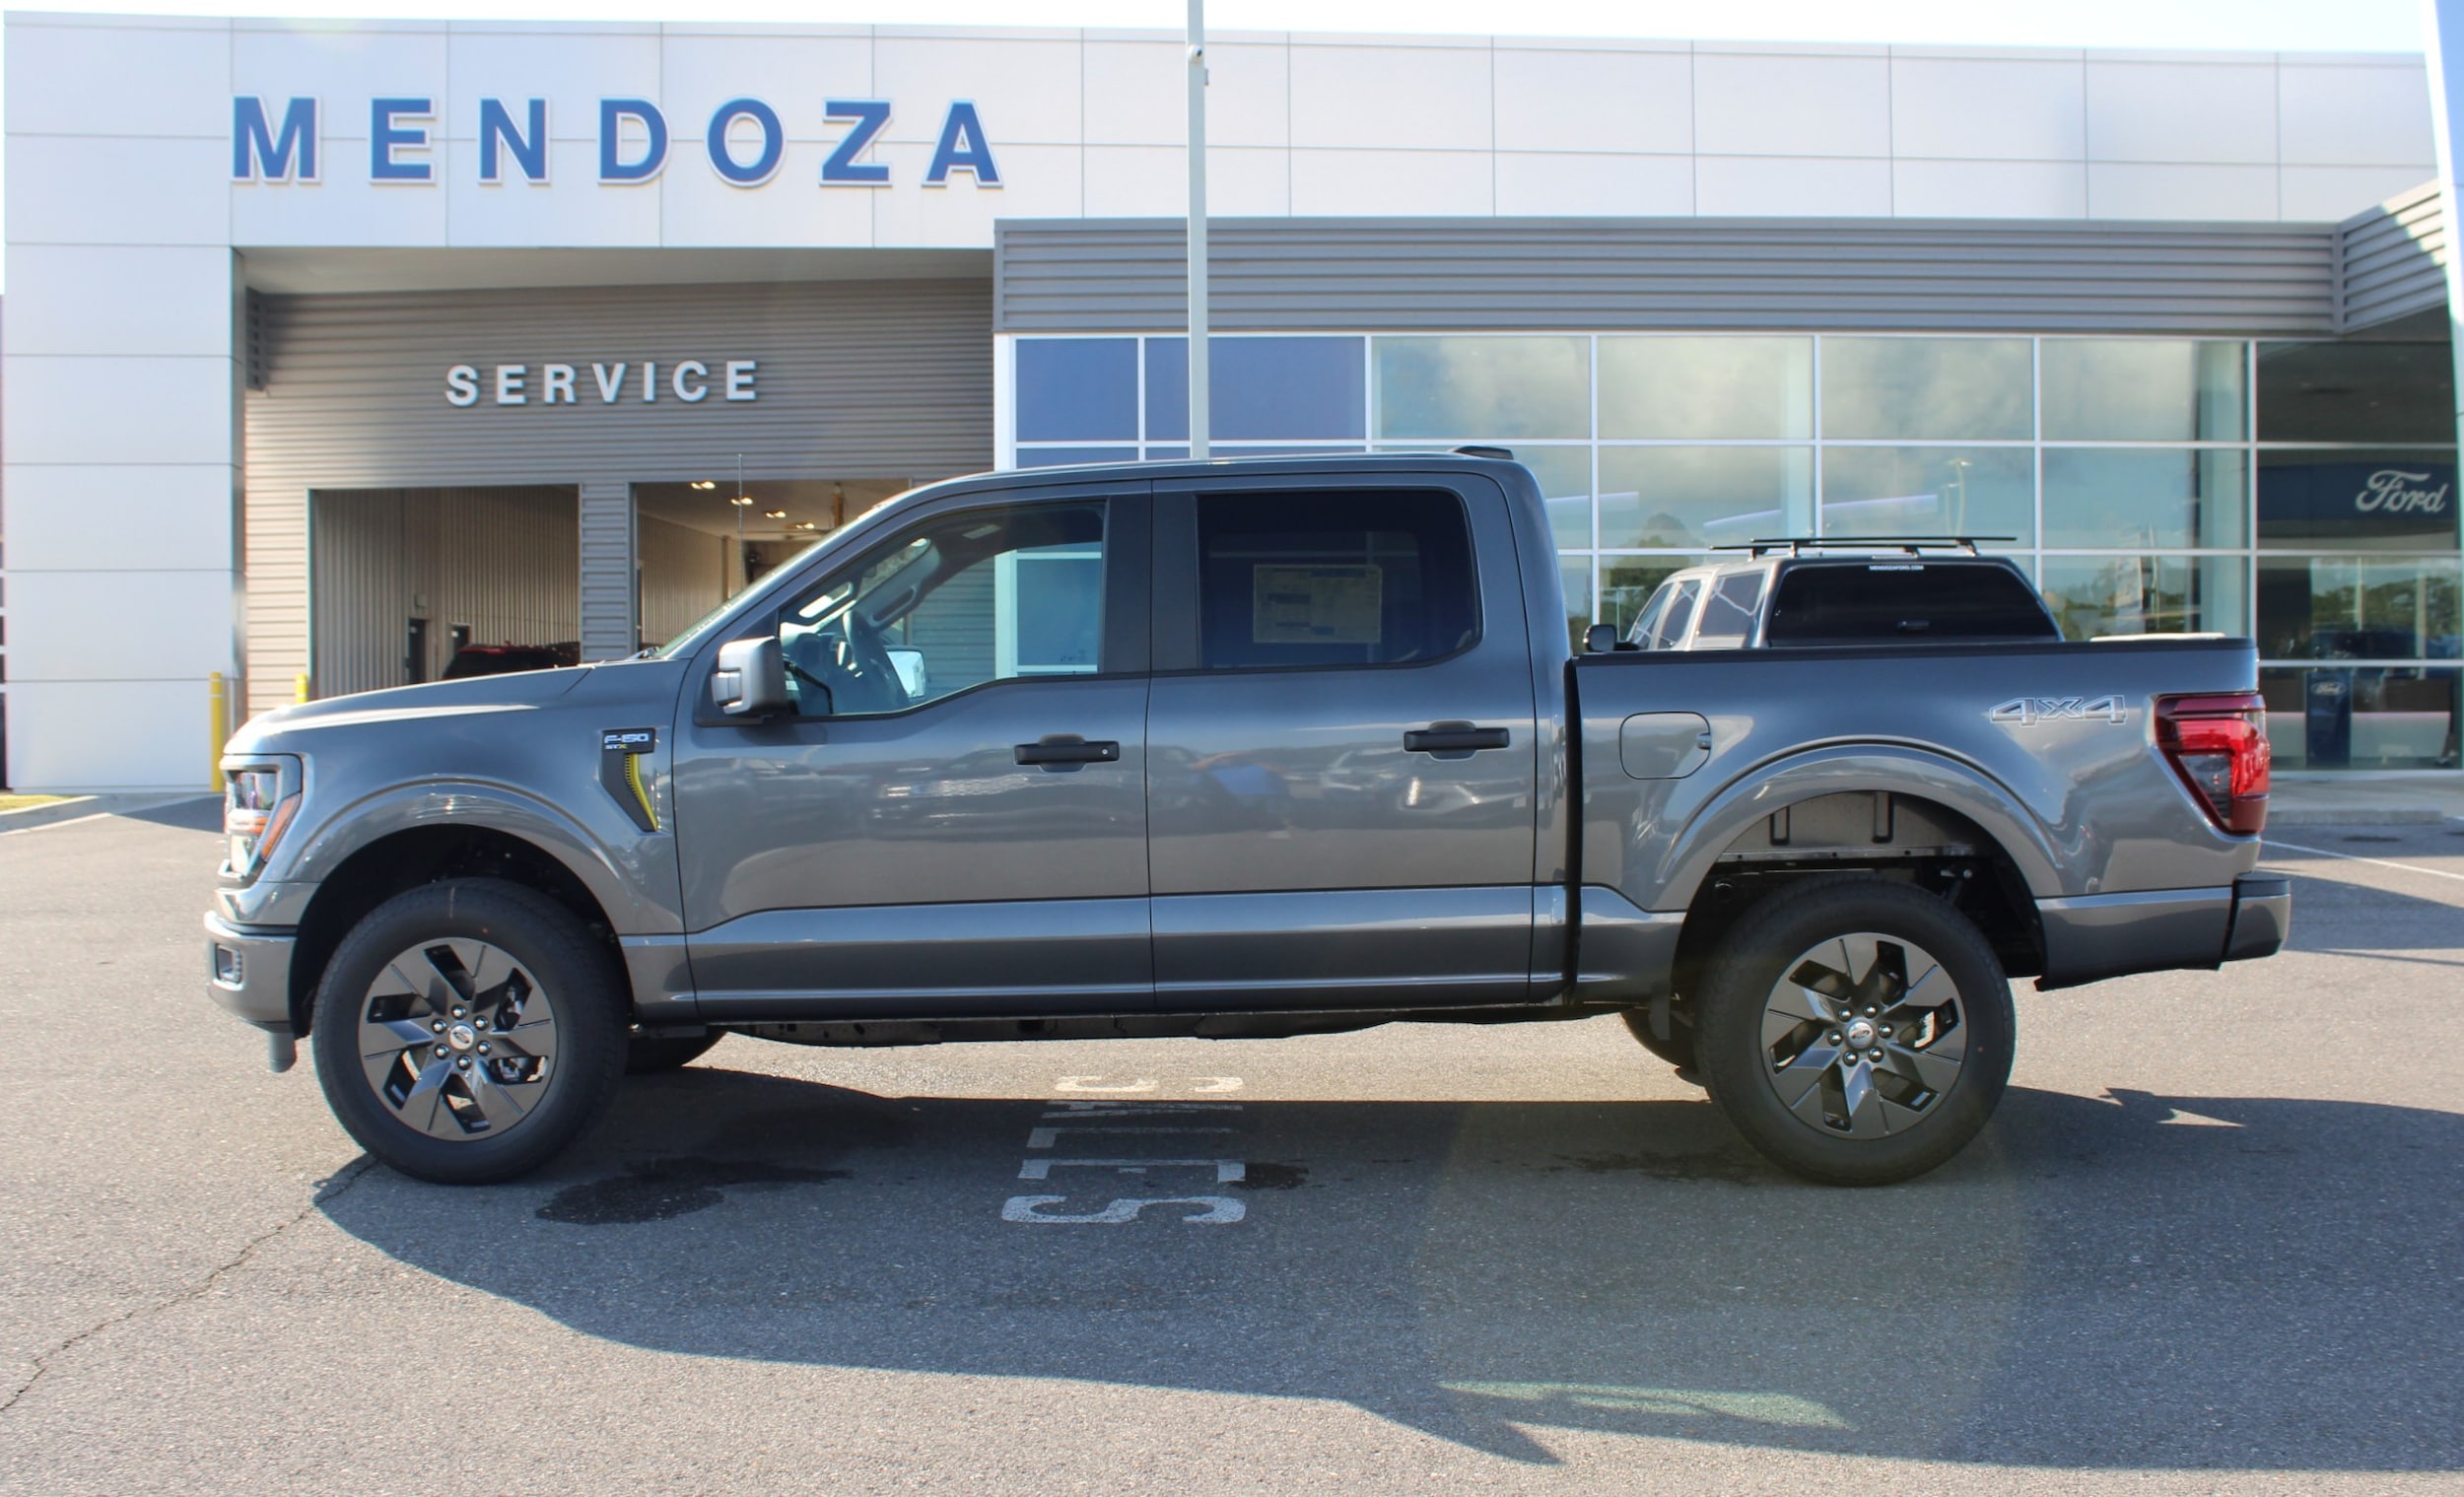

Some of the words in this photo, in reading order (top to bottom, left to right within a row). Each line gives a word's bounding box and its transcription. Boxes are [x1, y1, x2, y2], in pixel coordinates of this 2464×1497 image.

[232, 96, 1003, 187] MENDOZA
[445, 359, 759, 407] SERVICE
[2355, 469, 2449, 513] Ford
